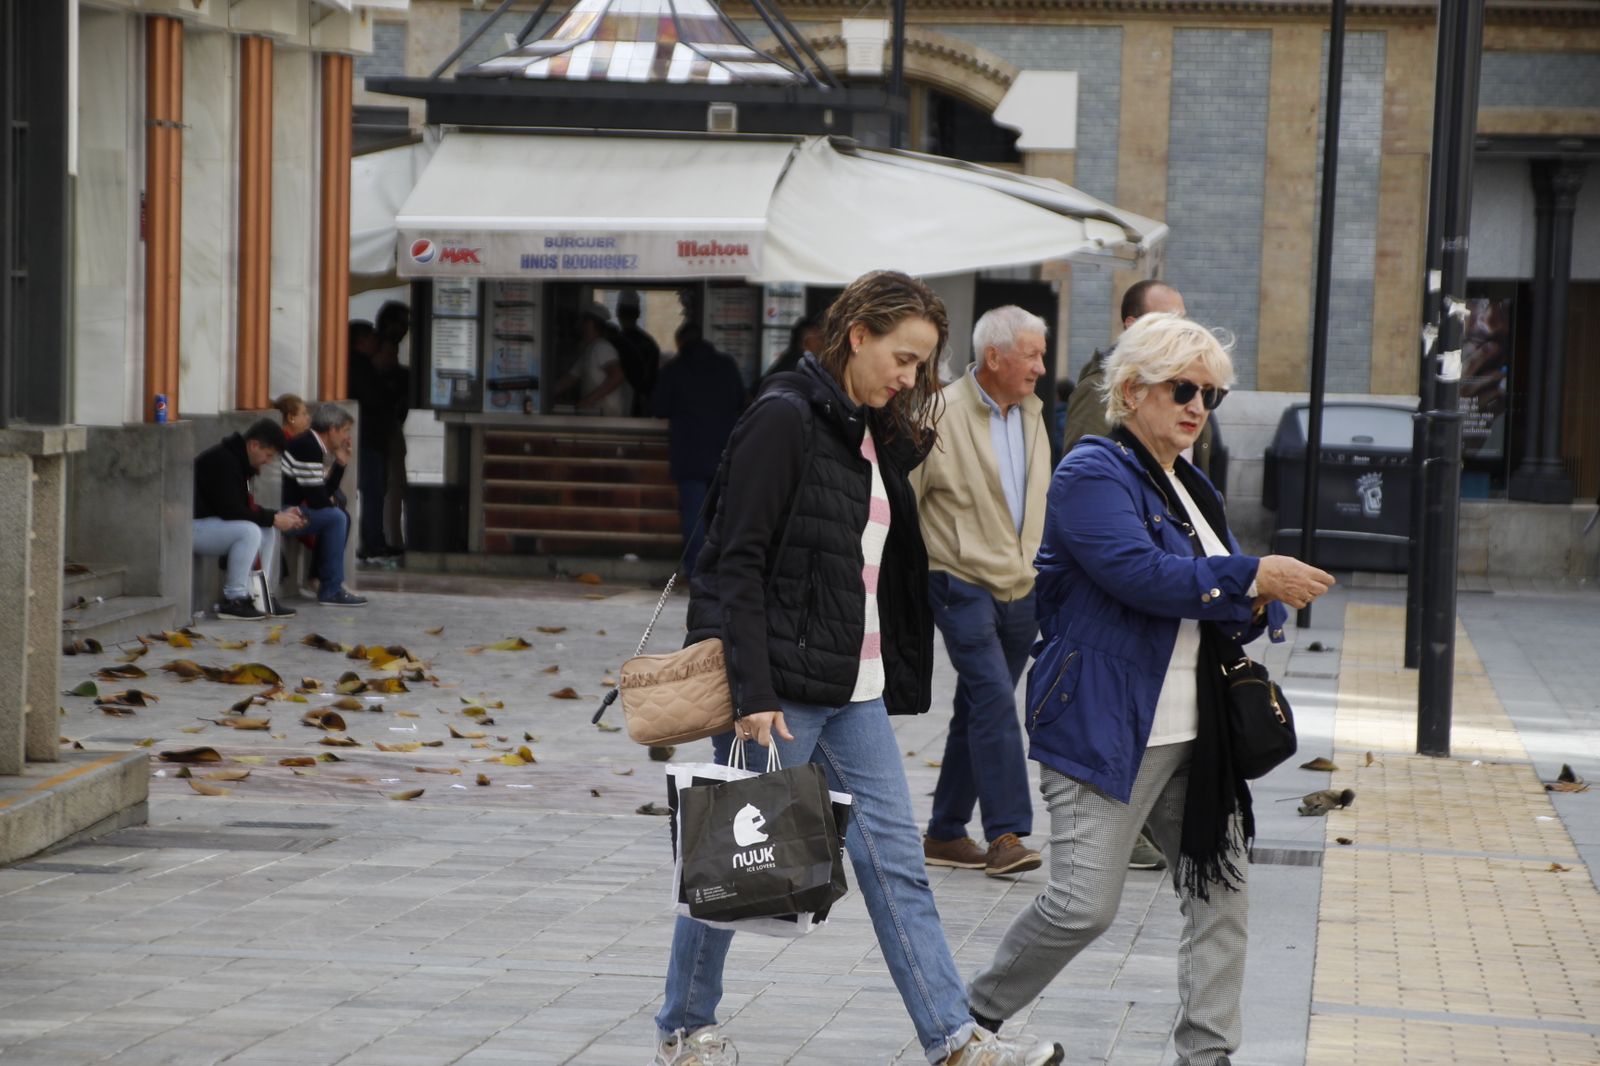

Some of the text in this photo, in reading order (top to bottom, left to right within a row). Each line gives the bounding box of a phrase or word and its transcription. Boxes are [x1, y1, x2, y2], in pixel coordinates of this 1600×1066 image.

[543, 236, 616, 248] BURGUER
[676, 239, 749, 257] Mahou
[438, 247, 482, 264] MAX
[756, 863, 776, 871] LOVERS
